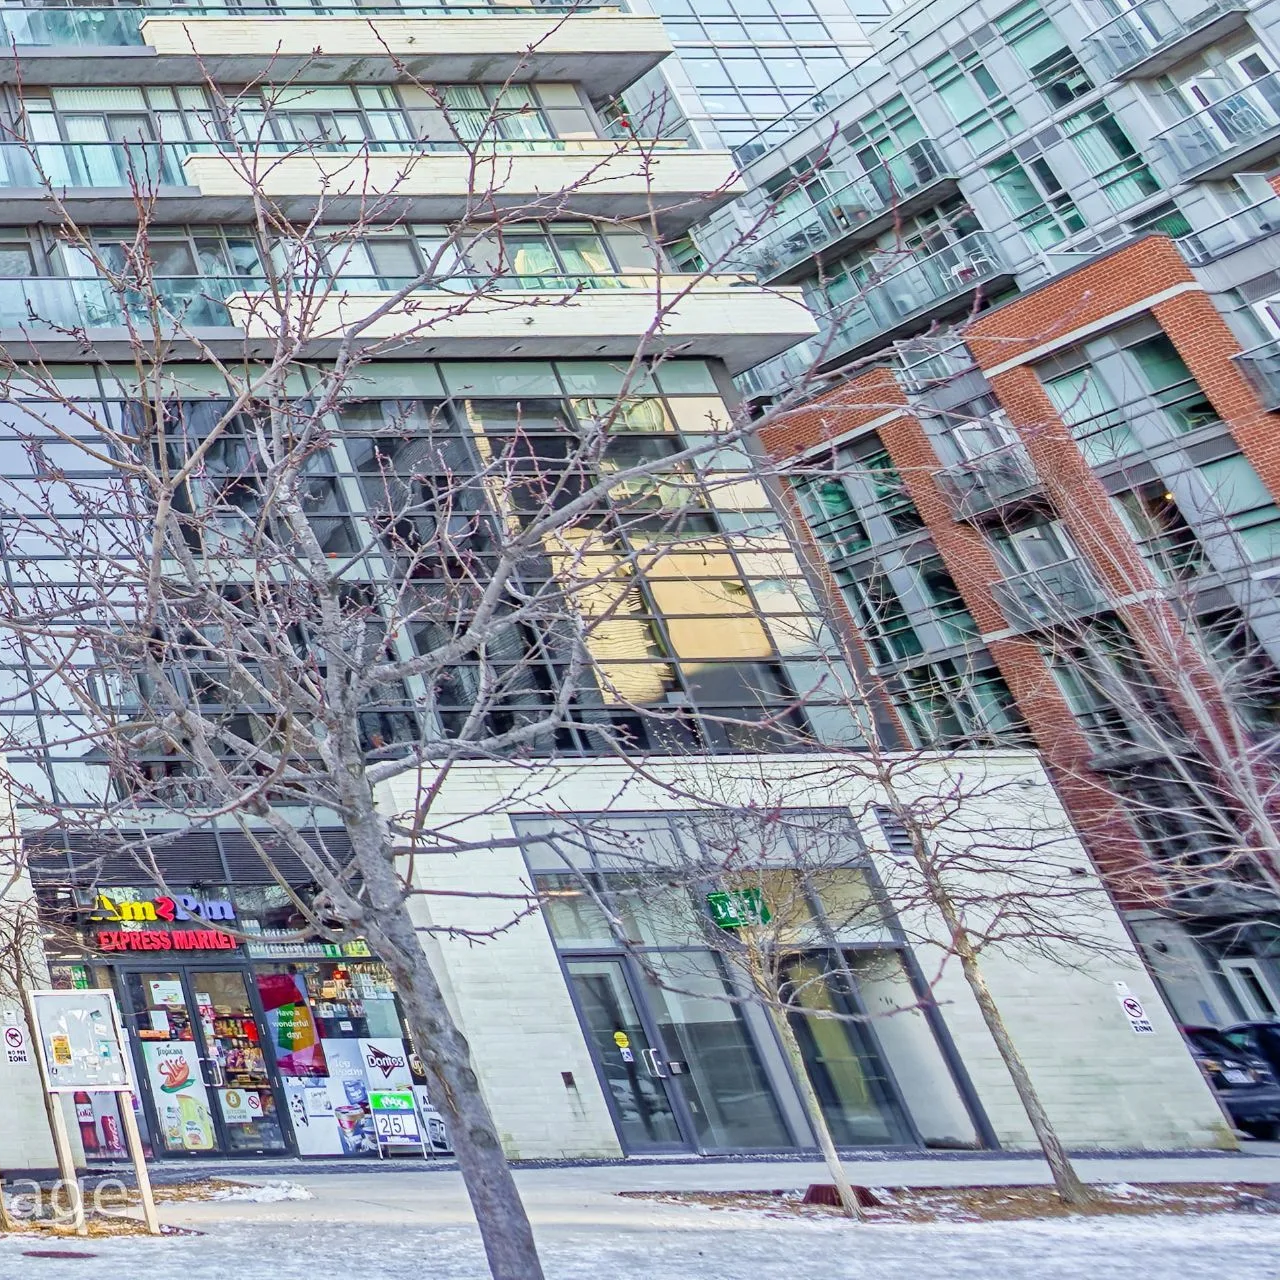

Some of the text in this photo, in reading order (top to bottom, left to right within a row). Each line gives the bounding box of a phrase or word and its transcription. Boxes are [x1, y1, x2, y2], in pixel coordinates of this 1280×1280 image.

[98, 930, 237, 951] EXPRESS MARKET
[272, 1020, 309, 1028] wonderful
[156, 1046, 183, 1056] Tropicana
[367, 1055, 404, 1068] Doritos
[158, 1056, 185, 1083] Slice
